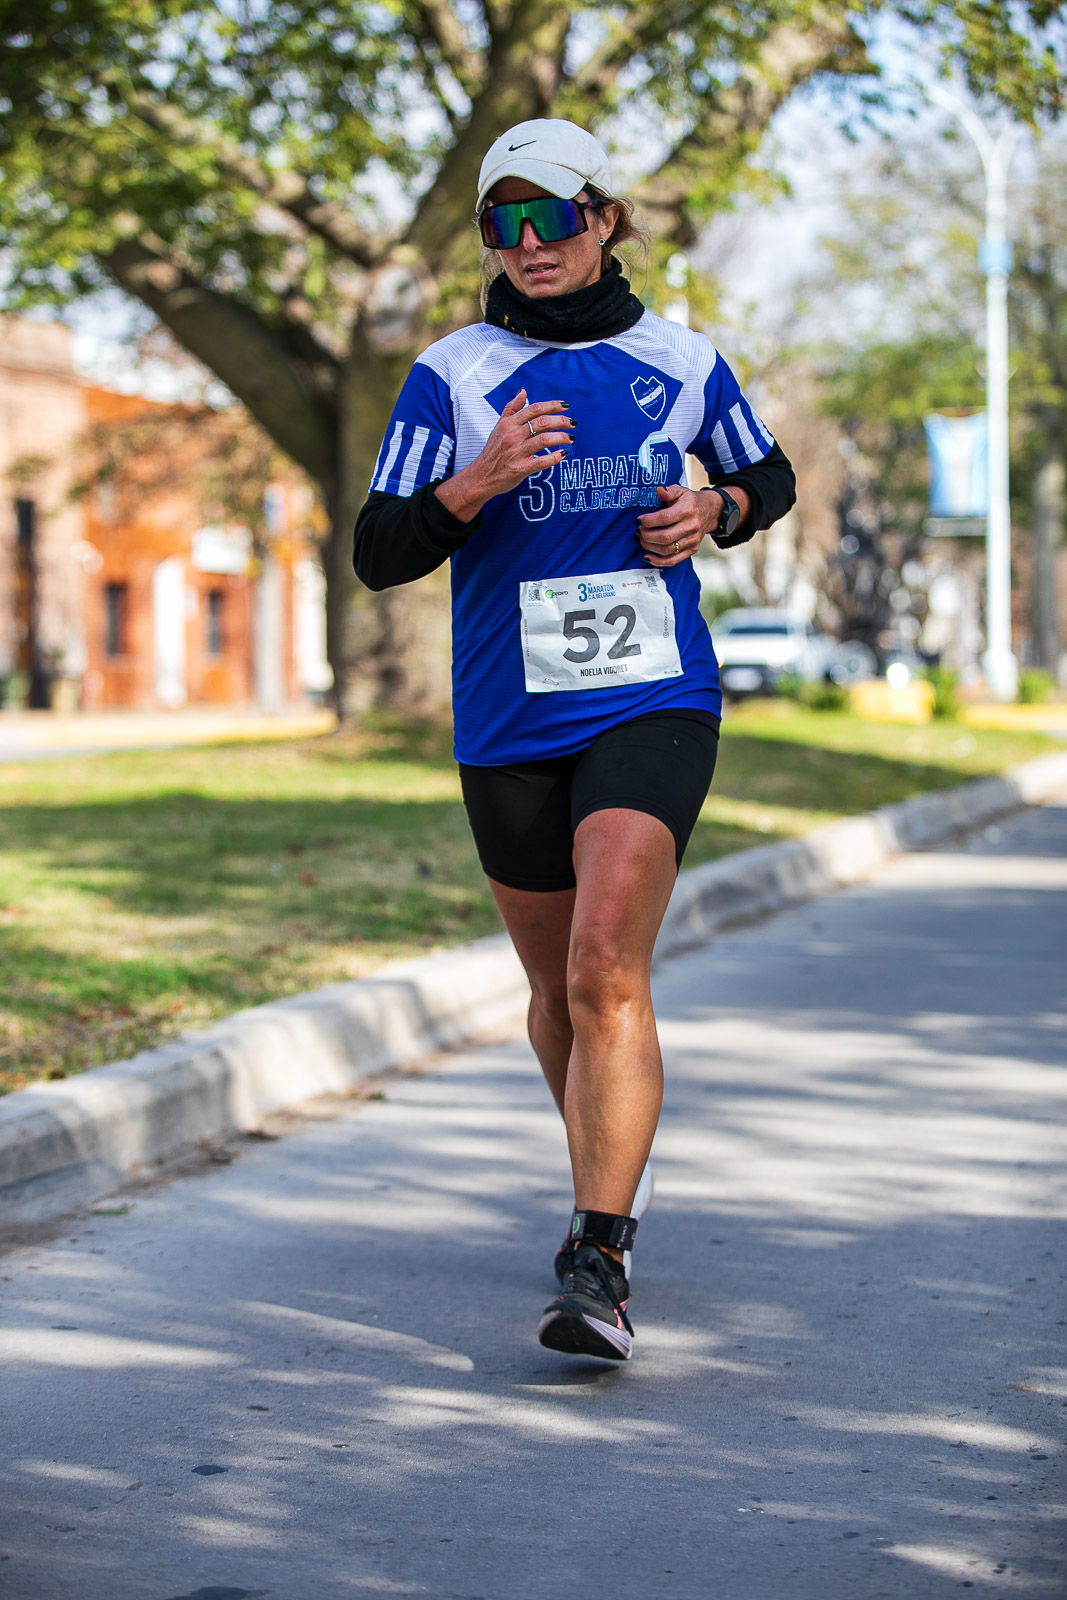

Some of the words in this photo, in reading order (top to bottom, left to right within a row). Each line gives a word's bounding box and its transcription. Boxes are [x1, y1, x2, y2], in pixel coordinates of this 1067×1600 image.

[518, 447, 556, 522] 3
[559, 448, 669, 490] MARATÓN
[577, 583, 587, 602] 3
[587, 583, 615, 594] MARATÓN
[562, 604, 642, 663] 52
[580, 667, 603, 677] NOELIA
